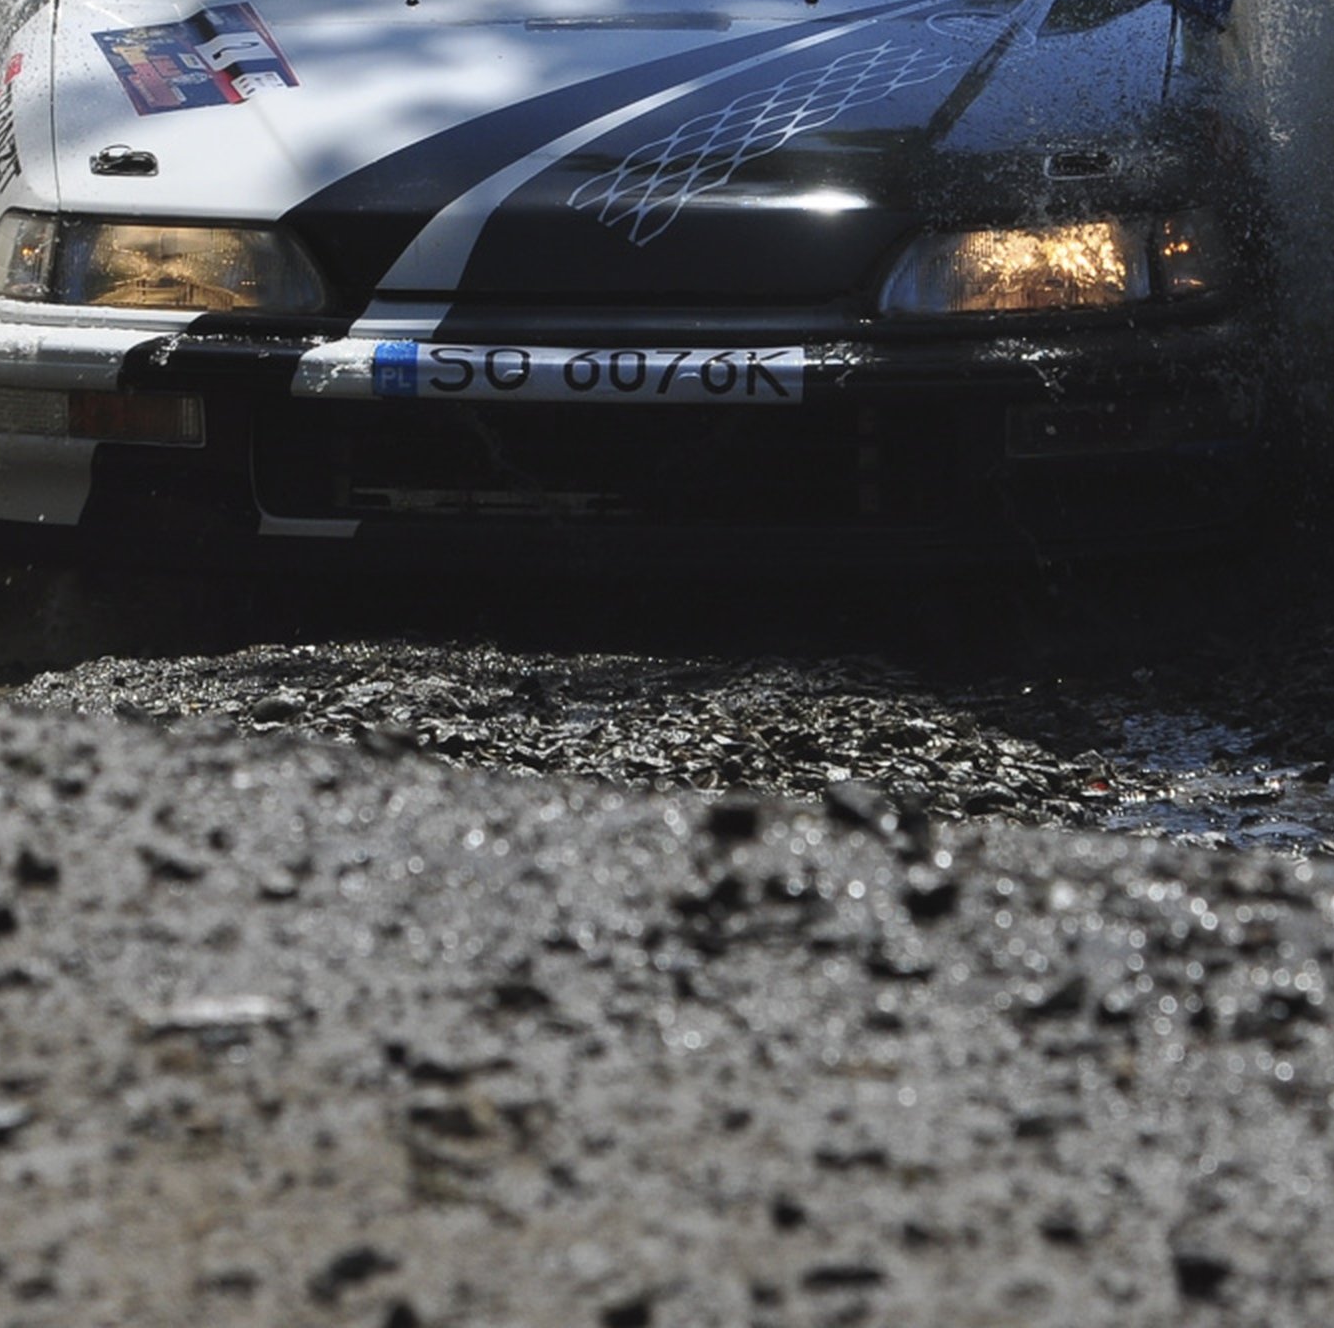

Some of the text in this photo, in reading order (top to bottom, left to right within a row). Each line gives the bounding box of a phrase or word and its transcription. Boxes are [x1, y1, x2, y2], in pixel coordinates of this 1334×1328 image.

[380, 366, 412, 390] PL
[428, 347, 791, 397] SO 6076K
